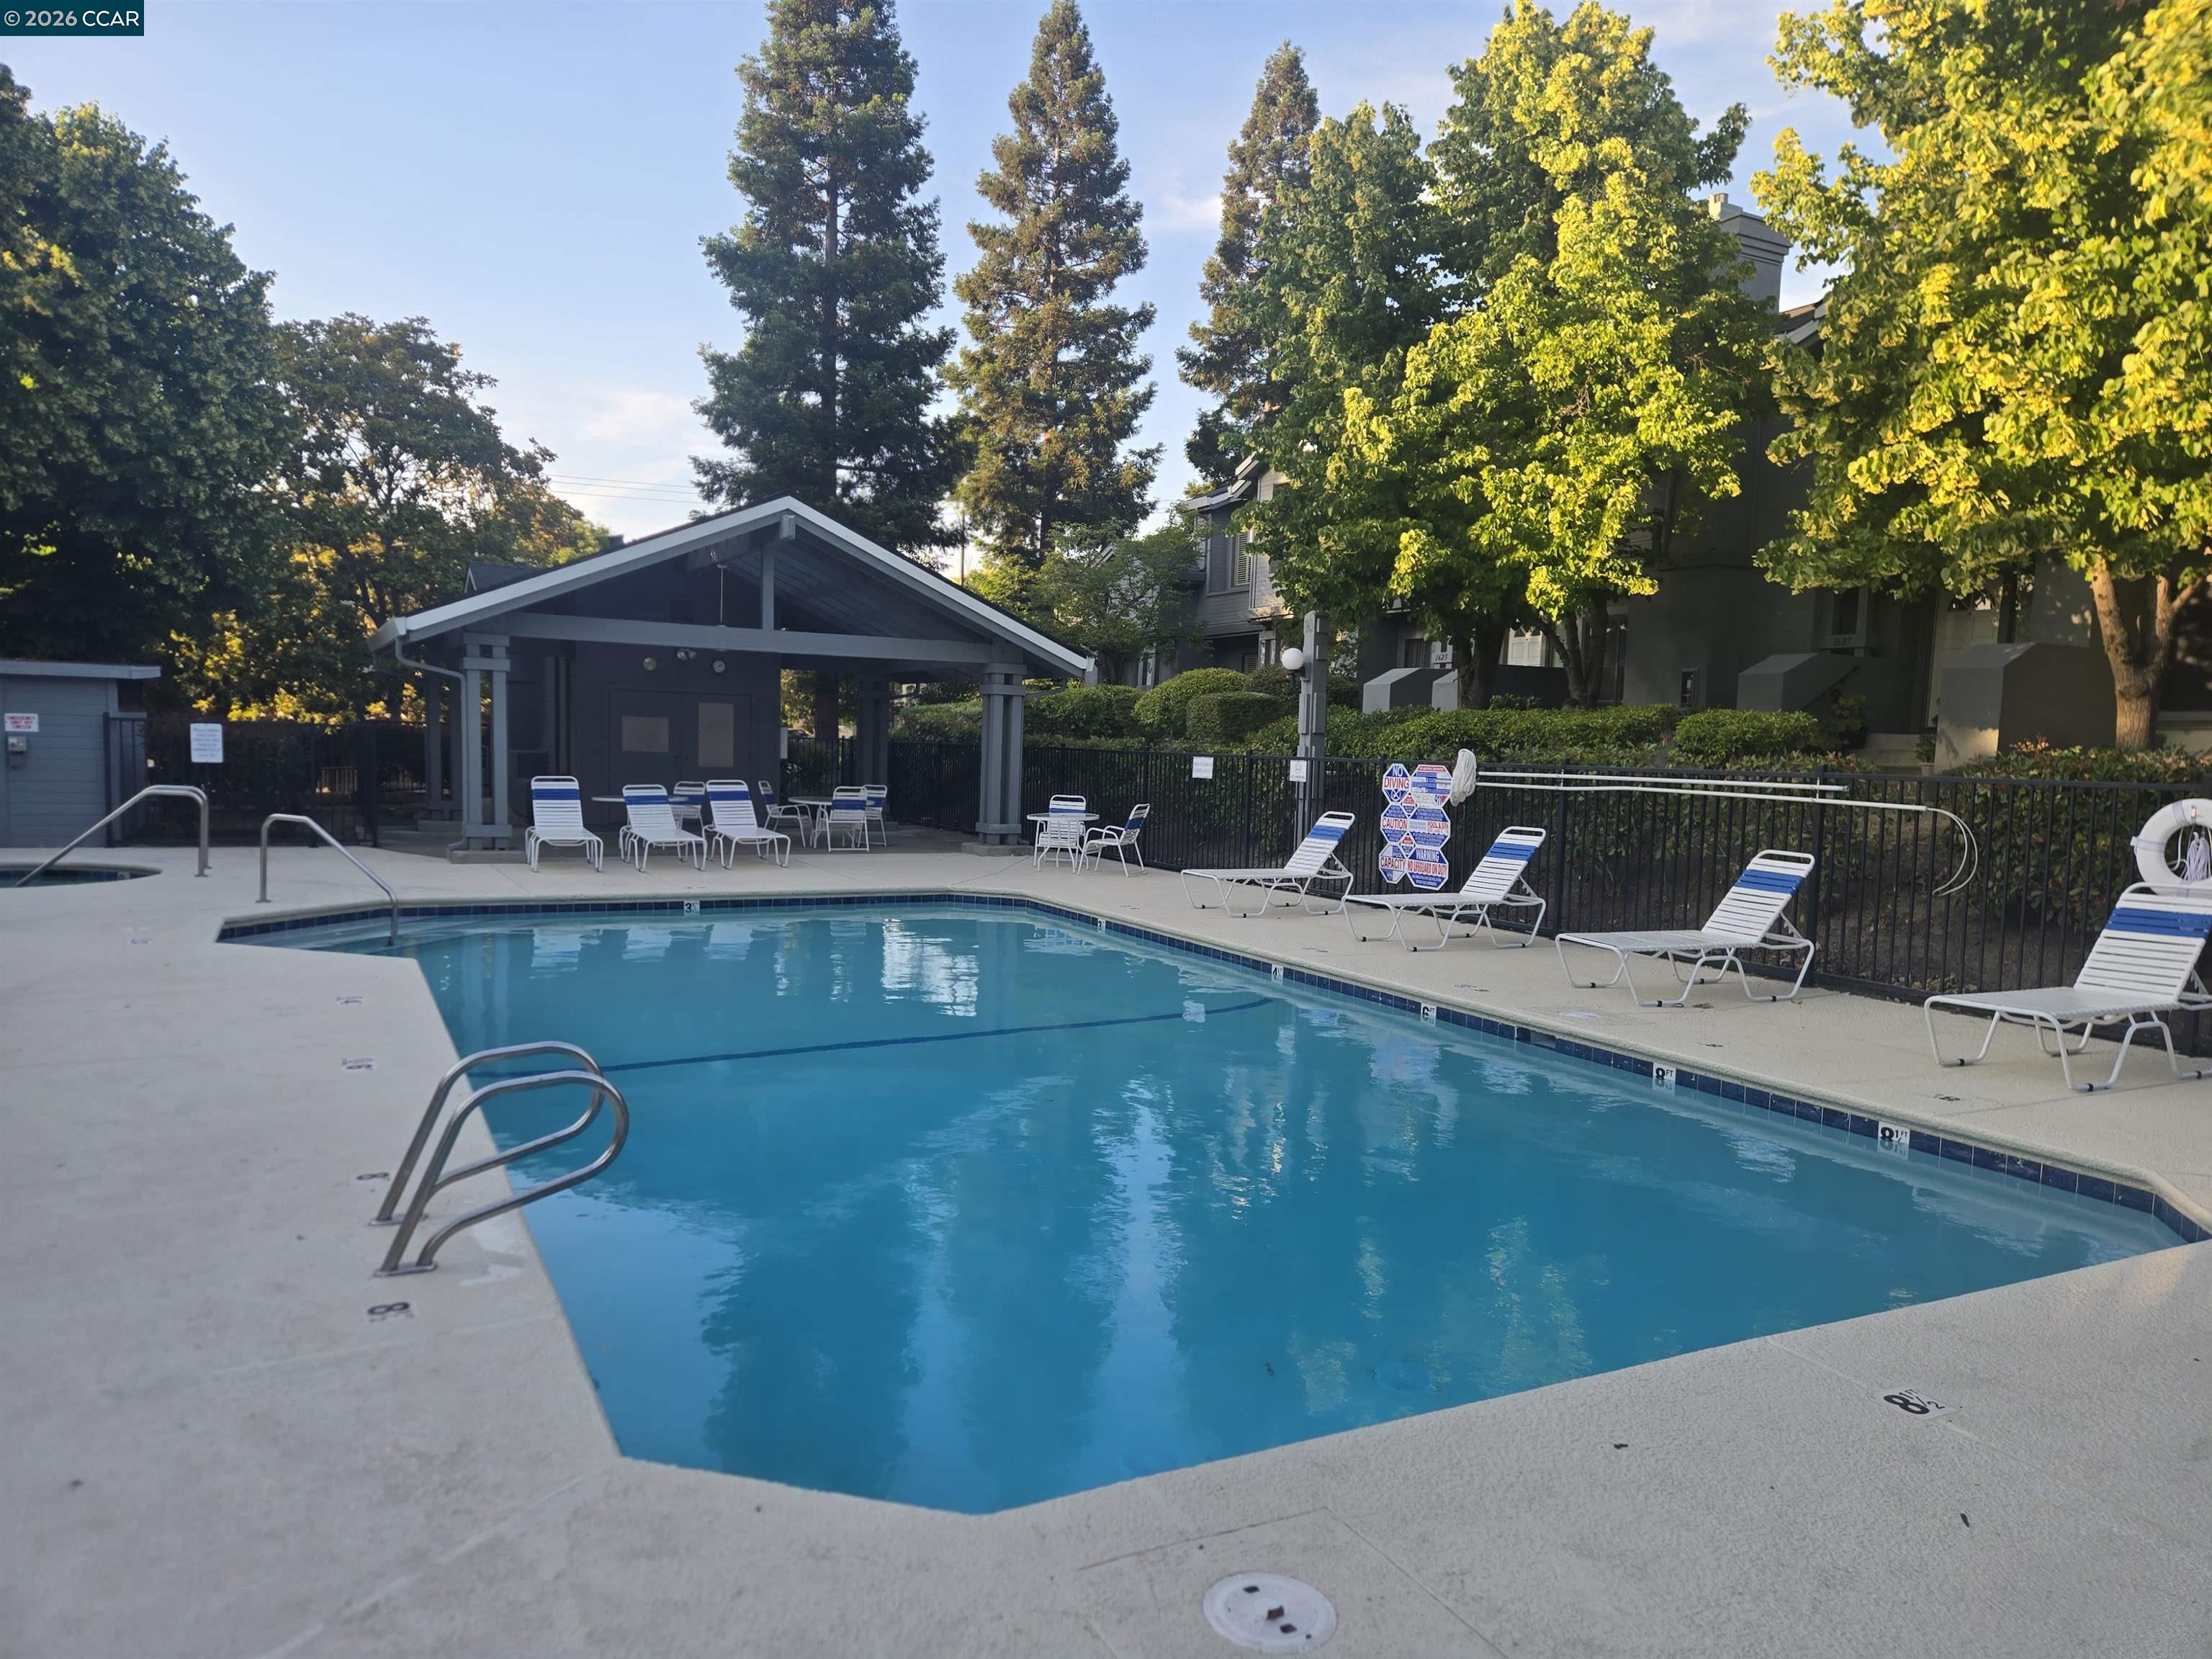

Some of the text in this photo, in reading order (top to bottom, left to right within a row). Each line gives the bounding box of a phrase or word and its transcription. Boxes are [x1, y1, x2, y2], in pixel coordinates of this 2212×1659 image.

[1393, 765, 1403, 776] NO
[1384, 778, 1409, 789] DIVING
[1382, 818, 1406, 829] CAUTION
[1416, 850, 1439, 862] WARNING
[1381, 858, 1406, 871] CAPACITY
